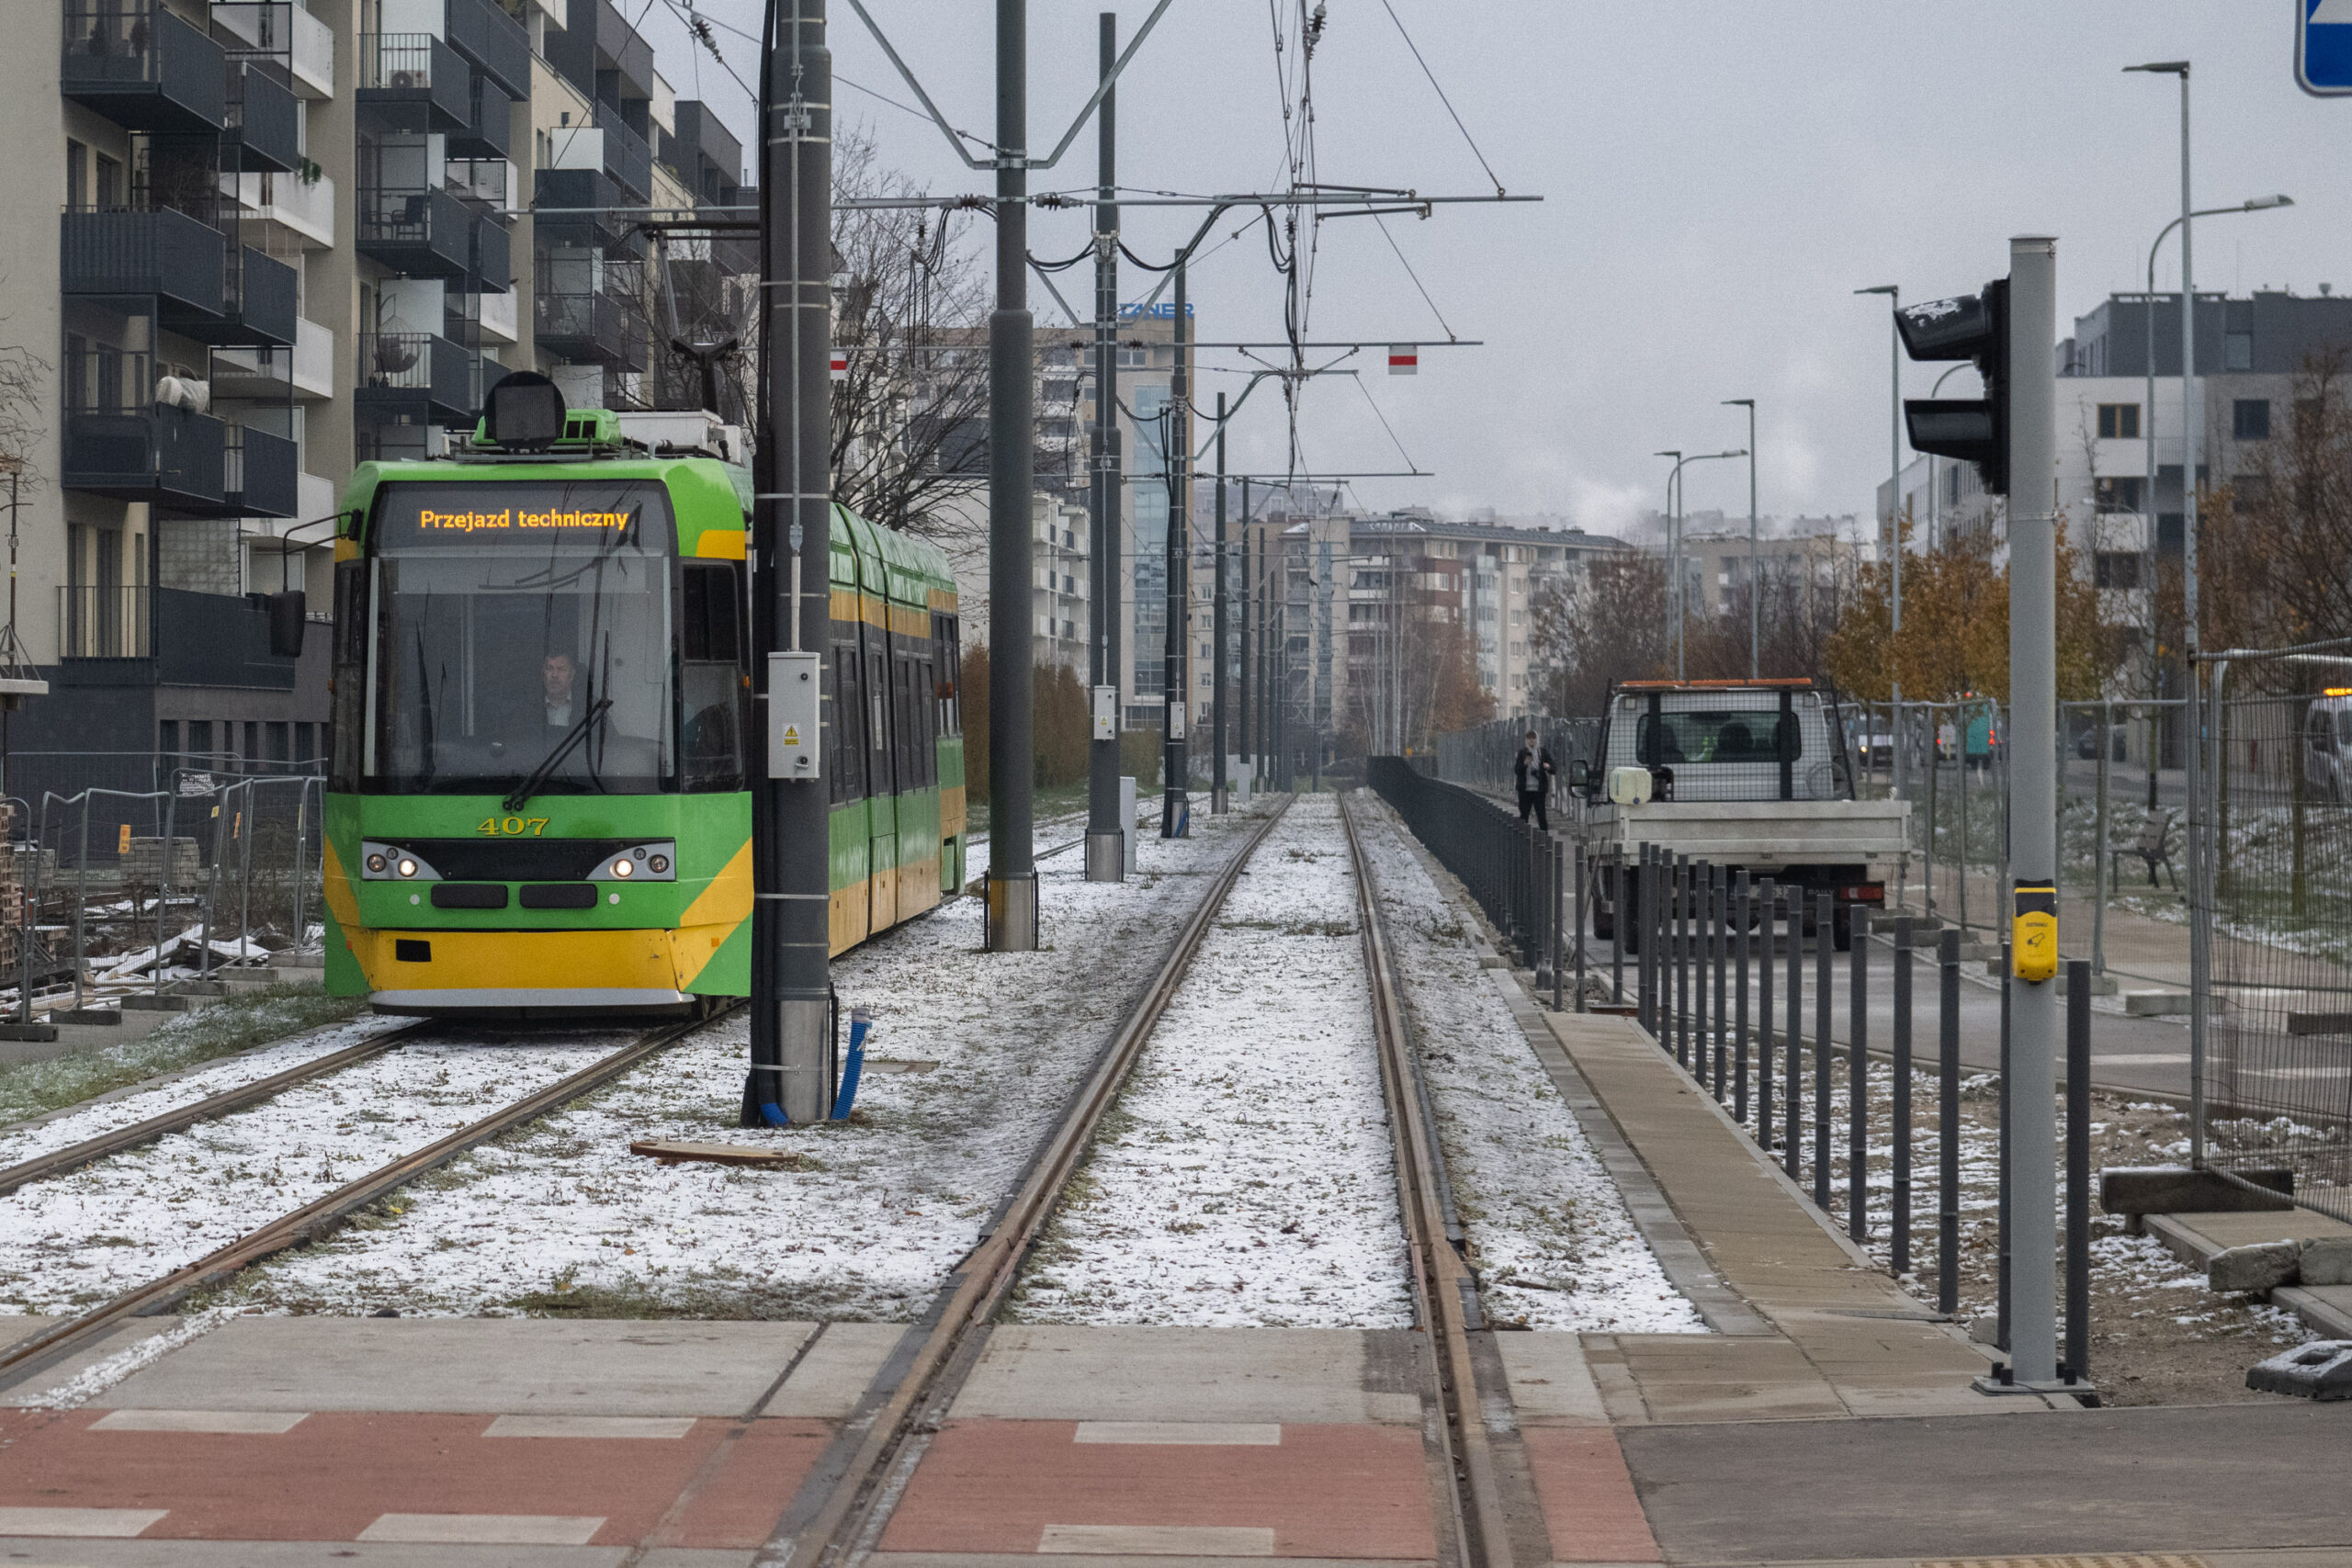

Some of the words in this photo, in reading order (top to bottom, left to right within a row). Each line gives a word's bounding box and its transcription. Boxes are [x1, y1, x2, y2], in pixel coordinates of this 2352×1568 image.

[1117, 302, 1194, 320] TANER
[420, 508, 511, 533] Przejazd
[517, 508, 630, 532] techniczny
[477, 817, 550, 837] 407
